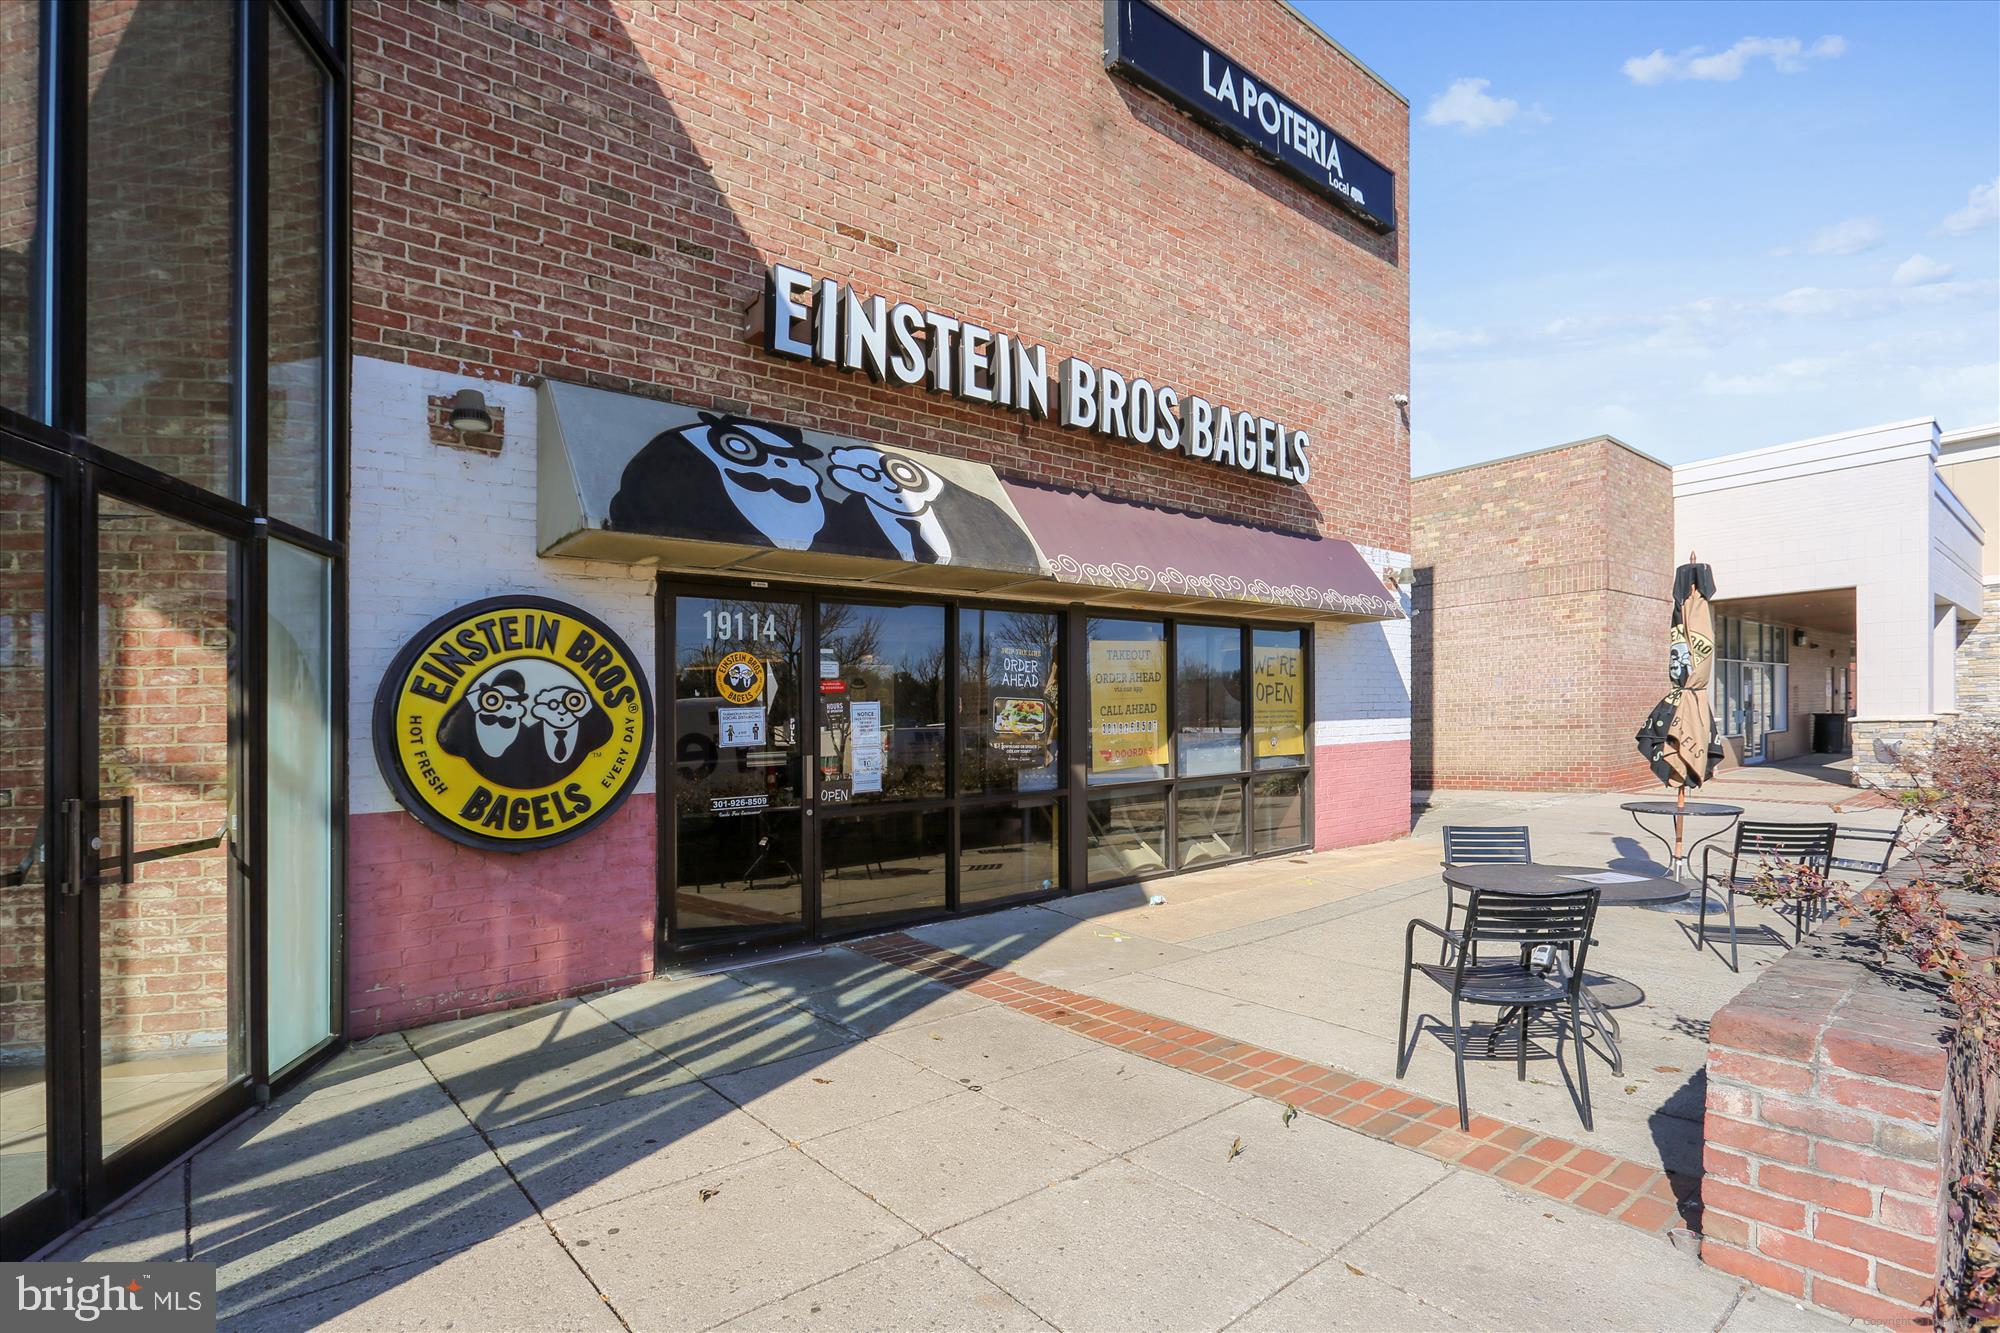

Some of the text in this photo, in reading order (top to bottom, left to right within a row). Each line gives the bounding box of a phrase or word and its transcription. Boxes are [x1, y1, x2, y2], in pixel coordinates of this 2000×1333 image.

[1203, 50, 1343, 178] LA POTERIA
[1328, 172, 1349, 196] Local
[770, 262, 1311, 485] EINSTEIN BROS BAGELS
[703, 610, 777, 641] 19114
[410, 614, 561, 705] EINSTEIN
[719, 653, 763, 675] EINSTEIN BROS
[1003, 657, 1039, 674] ORDER
[1106, 649, 1151, 660] TAKEOUT
[1095, 671, 1162, 684] ORDER AHEAD
[1255, 655, 1297, 678] WE'RE
[1001, 672, 1040, 688] AHEAD
[727, 691, 754, 702] BAGELS
[1256, 682, 1293, 704] OPEN
[1100, 703, 1158, 717] CALL AHEAD
[409, 715, 448, 796] HOT FRESH
[601, 717, 636, 789] EVERY DAY
[712, 797, 767, 808] 301-926-8509
[820, 788, 849, 802] OPEN
[459, 782, 592, 832] BAGELS
